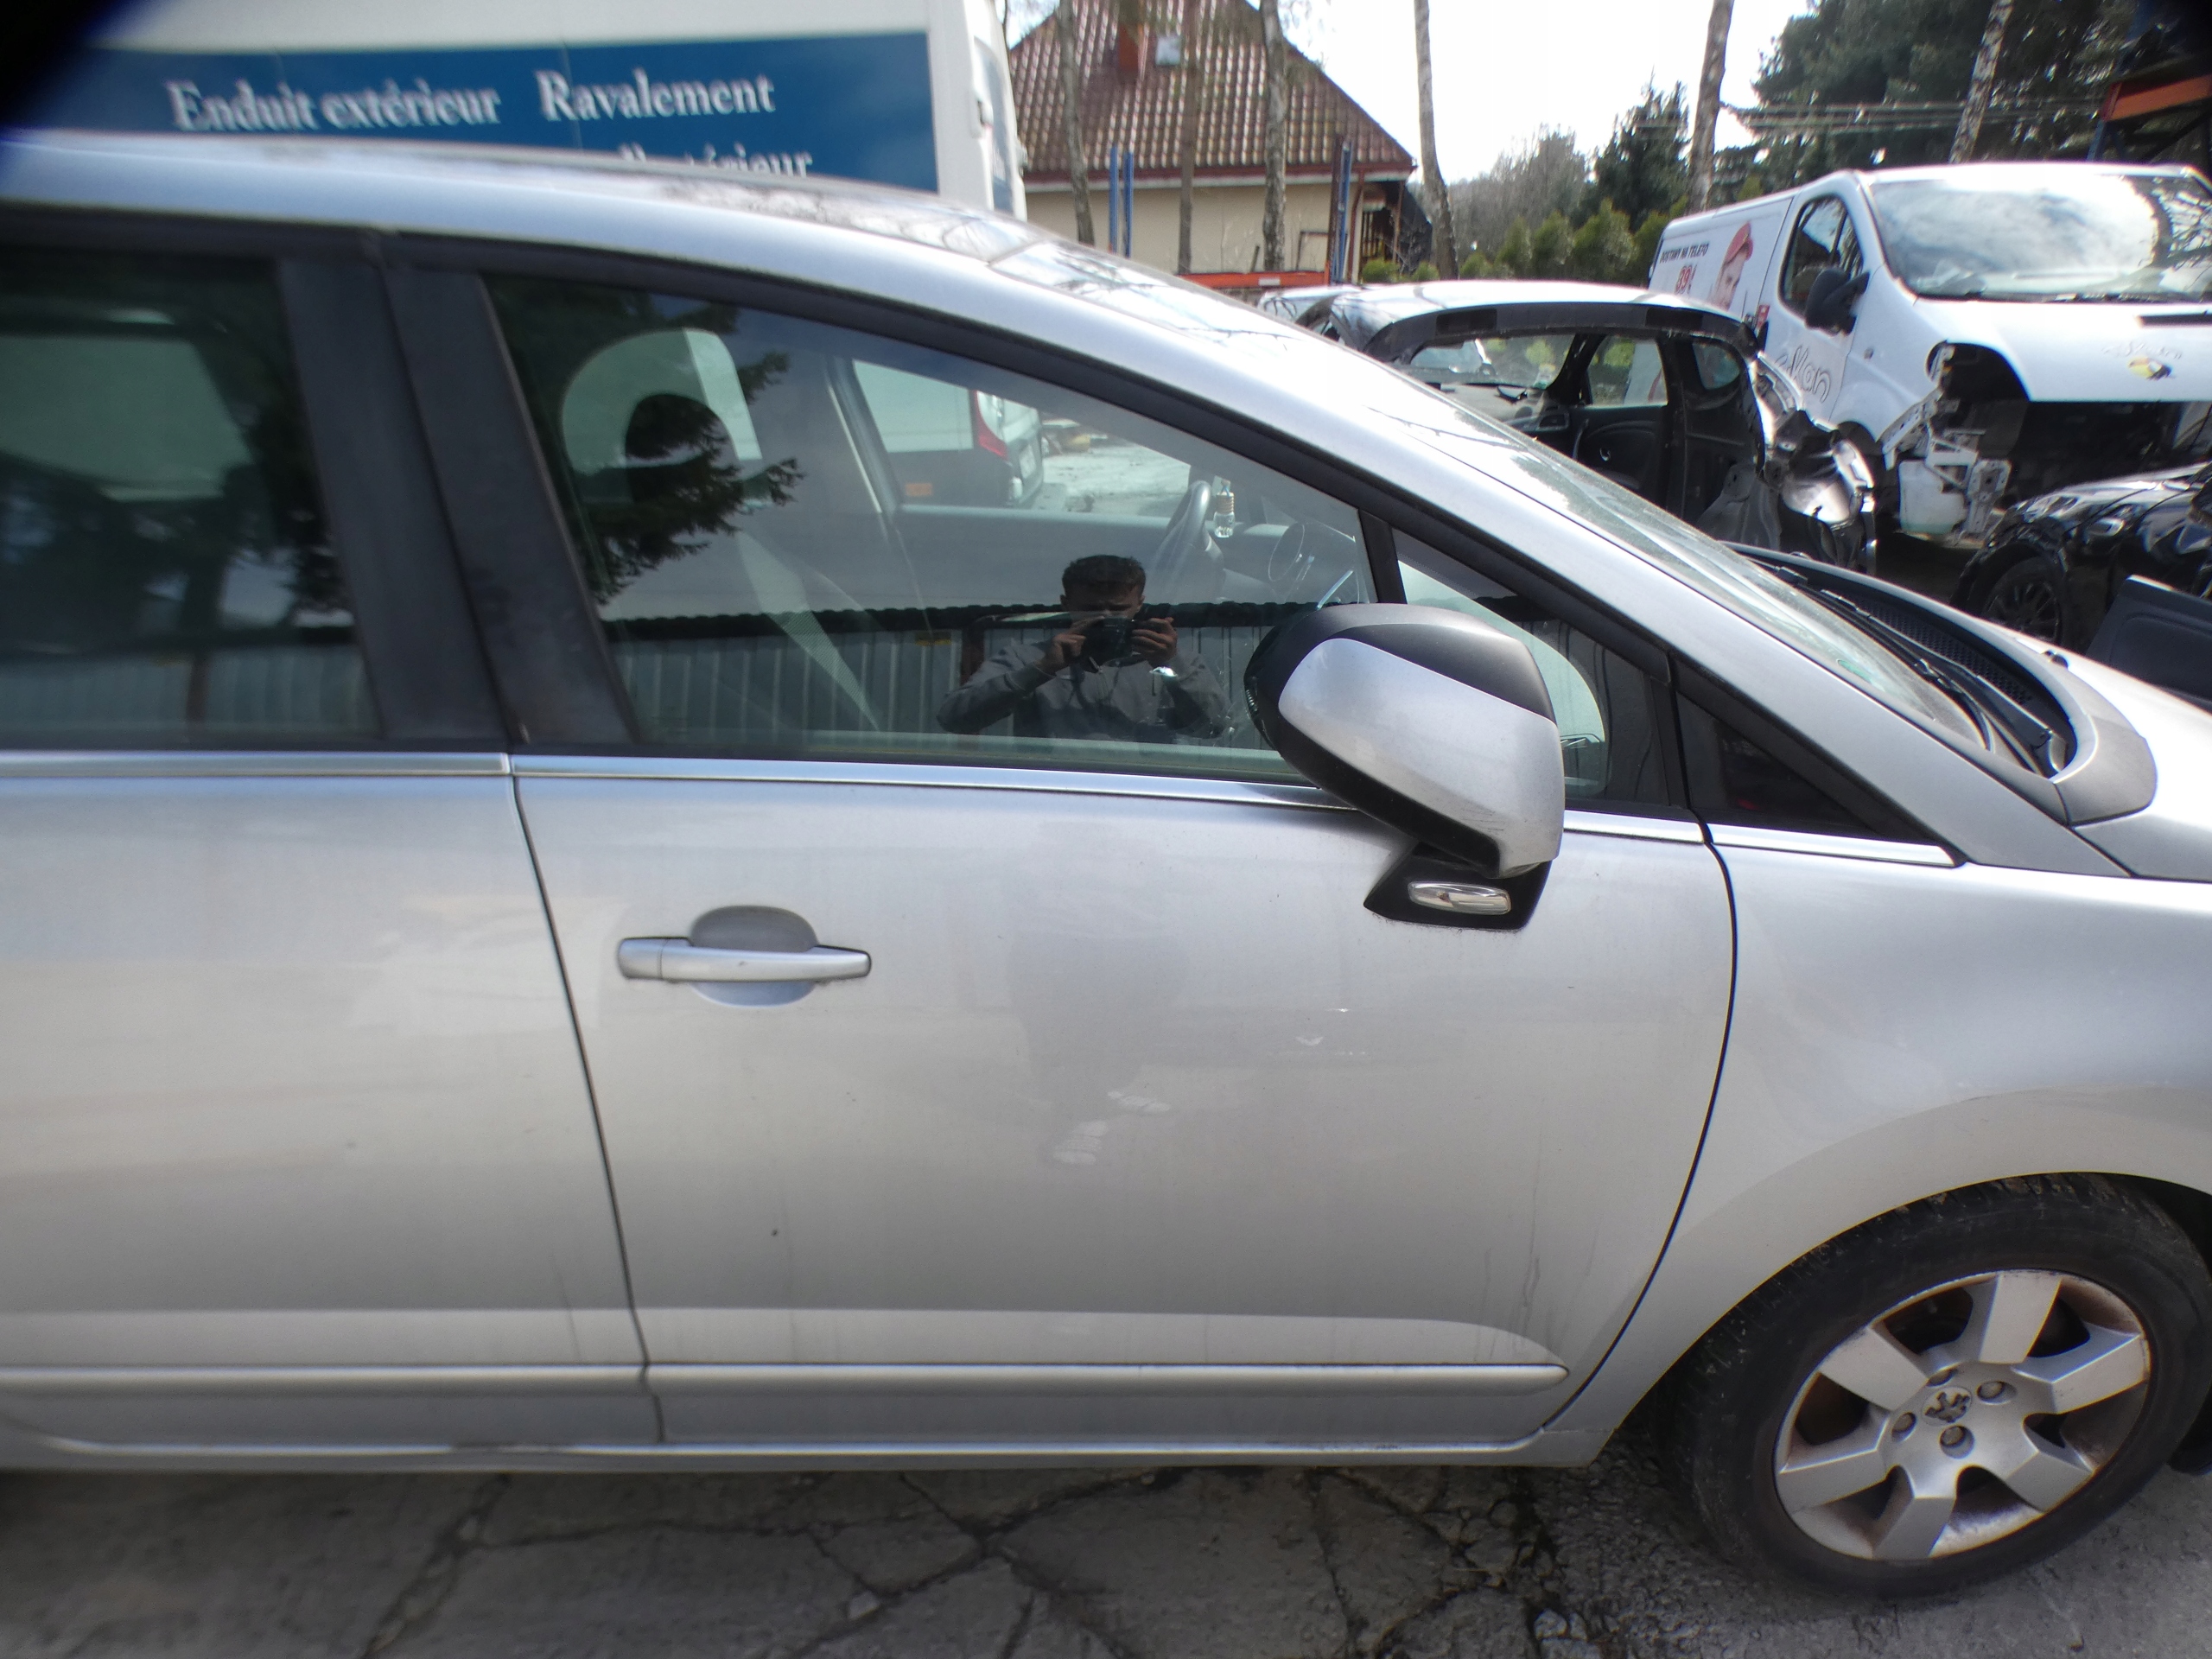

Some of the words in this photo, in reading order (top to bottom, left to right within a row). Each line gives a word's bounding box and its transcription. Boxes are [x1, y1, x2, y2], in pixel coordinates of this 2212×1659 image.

[166, 78, 320, 132] Enduit
[320, 77, 502, 129] extérieur
[534, 67, 777, 122] Ravalement
